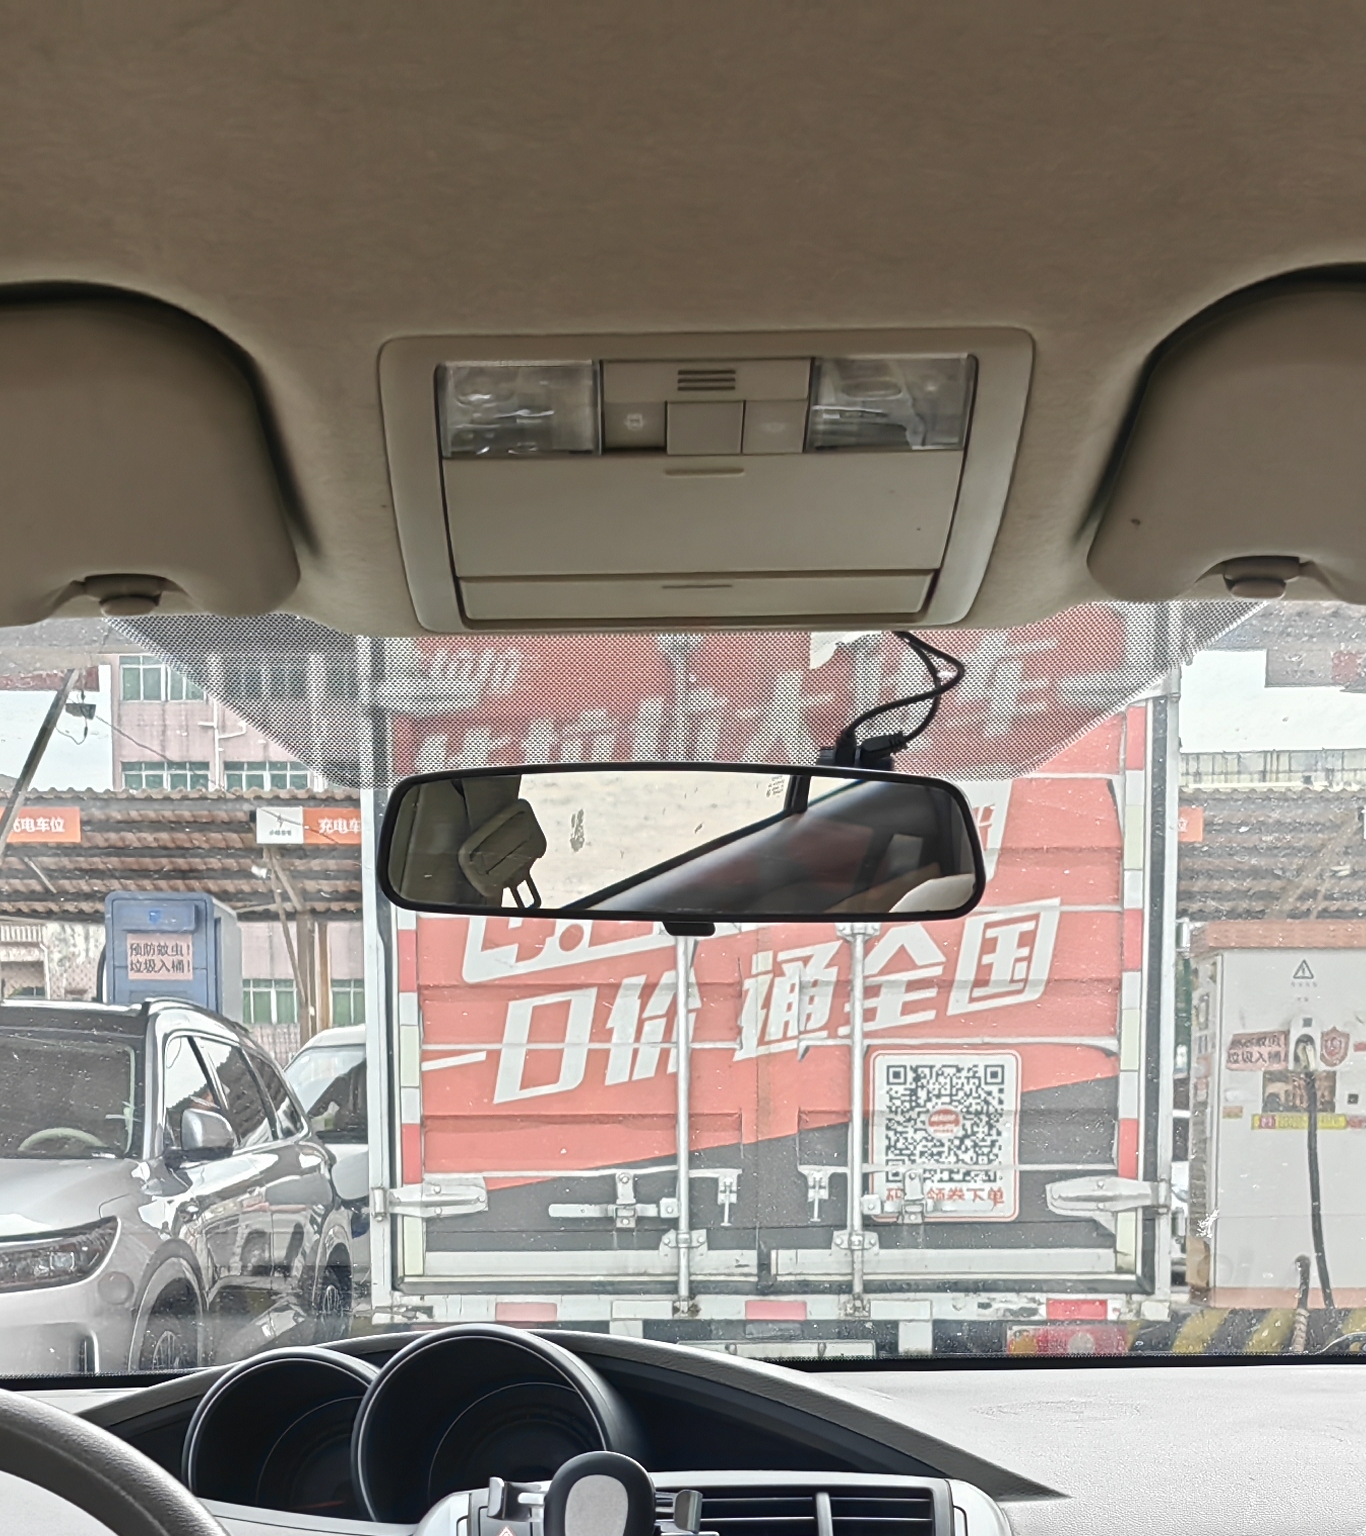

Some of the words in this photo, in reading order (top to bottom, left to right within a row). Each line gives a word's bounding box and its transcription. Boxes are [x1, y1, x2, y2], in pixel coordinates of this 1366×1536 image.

[418, 972, 703, 1105] 一口价
[734, 896, 1065, 1064] 通全国
